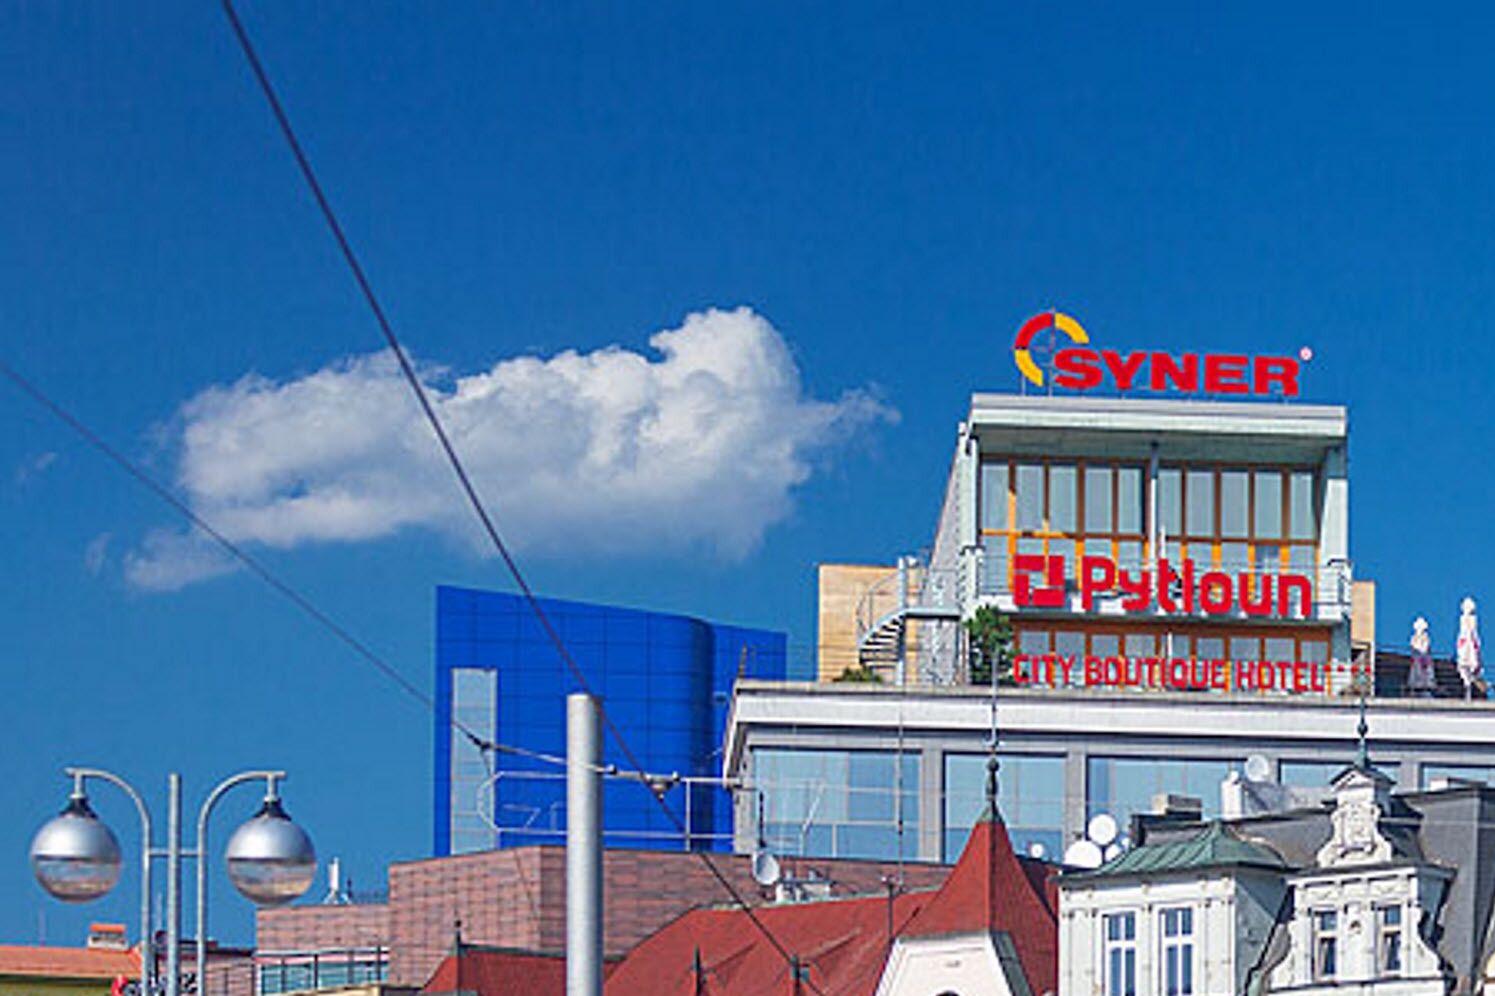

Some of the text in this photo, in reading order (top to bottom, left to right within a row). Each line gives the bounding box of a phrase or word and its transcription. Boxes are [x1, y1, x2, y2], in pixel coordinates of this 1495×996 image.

[1054, 348, 1299, 395] SYNER
[1081, 555, 1312, 617] Pytloun
[1012, 654, 1326, 693] CITY BOUTIQUE HOTEL
